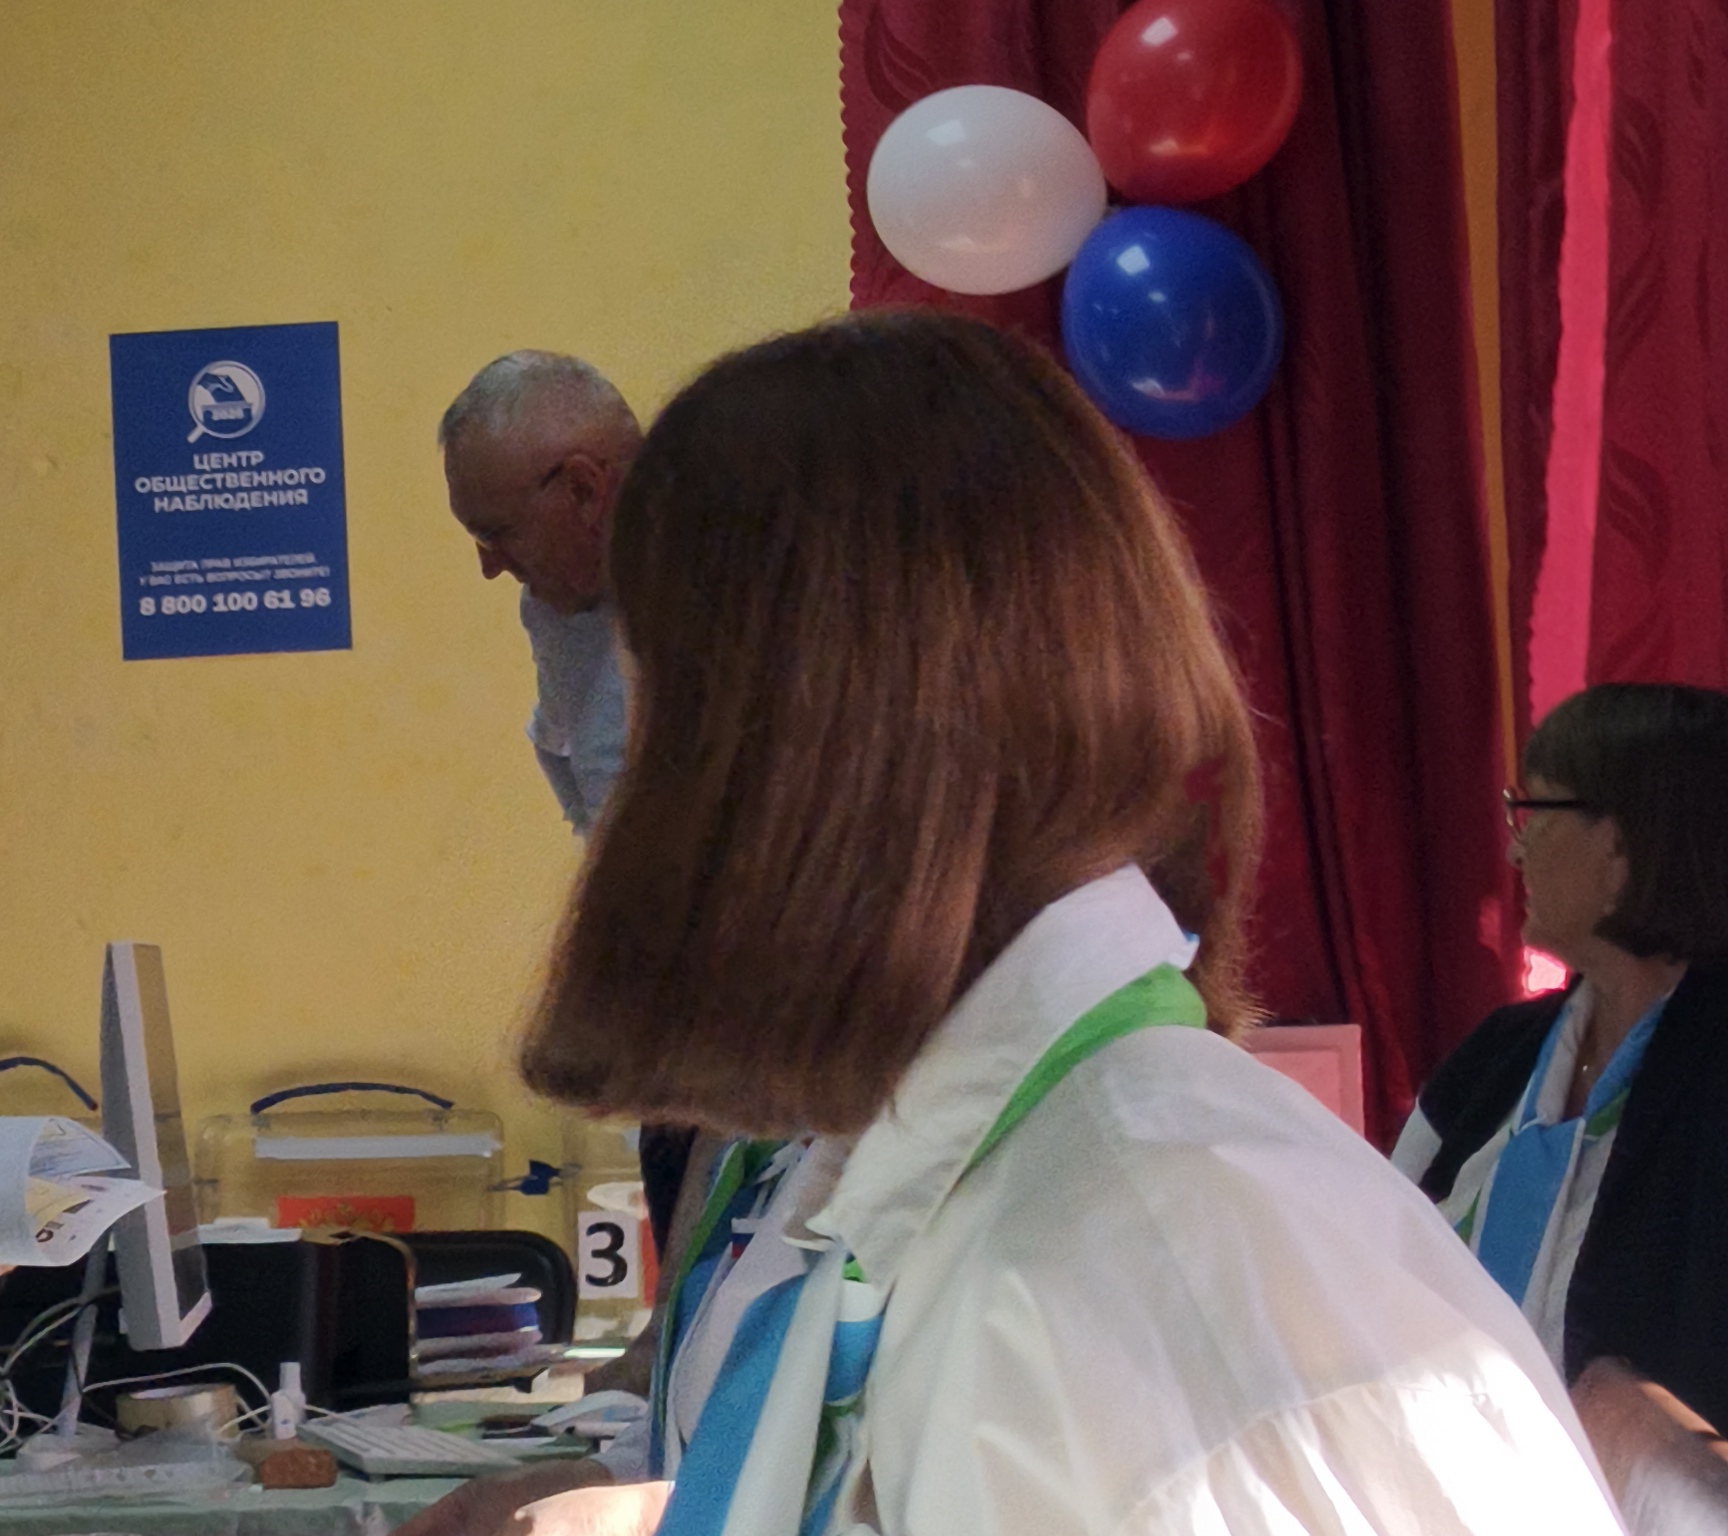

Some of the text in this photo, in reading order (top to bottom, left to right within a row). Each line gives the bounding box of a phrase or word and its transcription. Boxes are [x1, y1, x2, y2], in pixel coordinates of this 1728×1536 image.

[193, 450, 264, 471] ЦЕНТР
[134, 467, 326, 493] ОБЩЕСТВЕННОГО
[153, 489, 308, 513] НАБЛЮДЕНИЯ
[139, 596, 156, 616] 8
[161, 594, 207, 615] 800
[212, 591, 258, 612] 100
[263, 589, 296, 610] 61
[584, 1221, 628, 1287] 3
